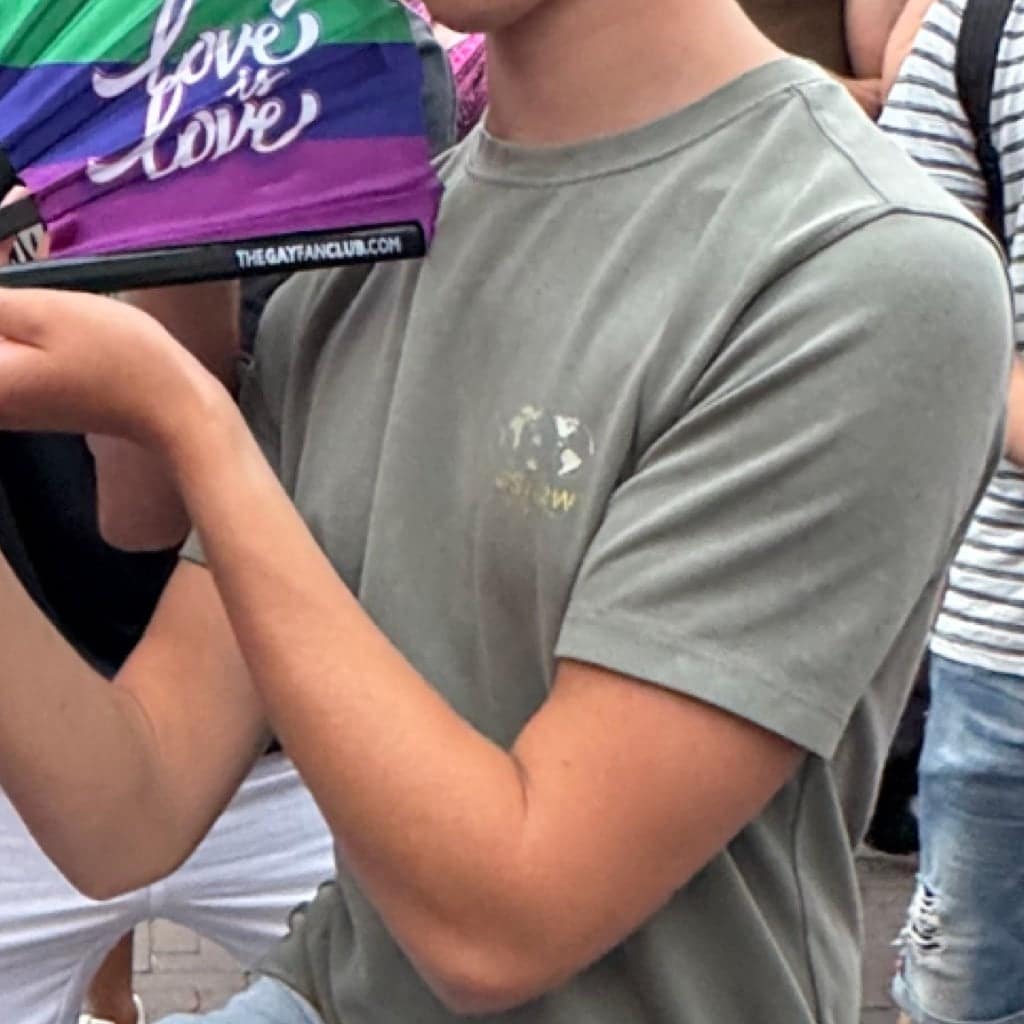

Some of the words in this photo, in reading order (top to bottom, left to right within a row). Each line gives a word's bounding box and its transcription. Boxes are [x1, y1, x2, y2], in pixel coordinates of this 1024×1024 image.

[228, 66, 290, 102] is
[87, 88, 319, 183] love
[236, 236, 402, 268] THEGAYFANCLUB.COM
